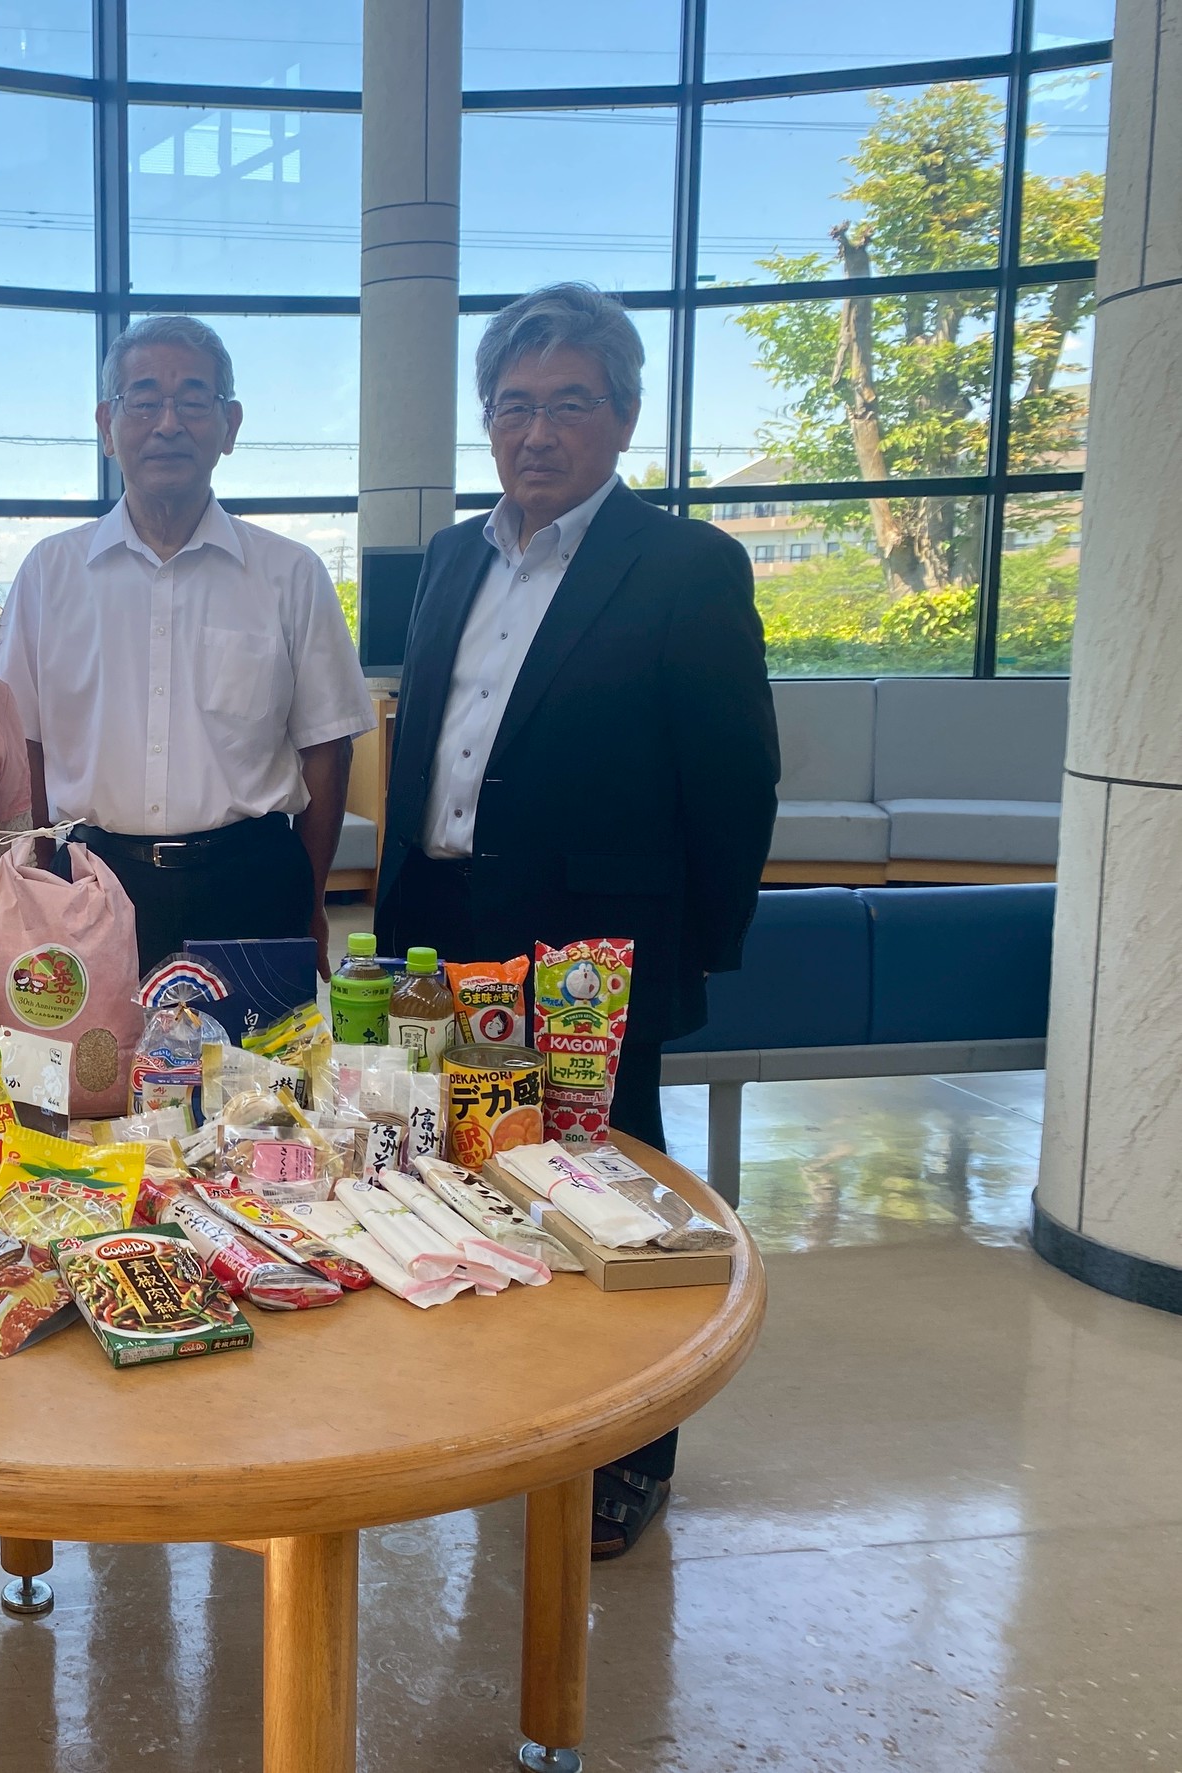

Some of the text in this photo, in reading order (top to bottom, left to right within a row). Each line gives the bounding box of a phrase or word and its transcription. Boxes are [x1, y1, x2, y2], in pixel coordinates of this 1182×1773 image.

[569, 1057, 594, 1068] カゴメ
[450, 1070, 516, 1085] DEKAMORI
